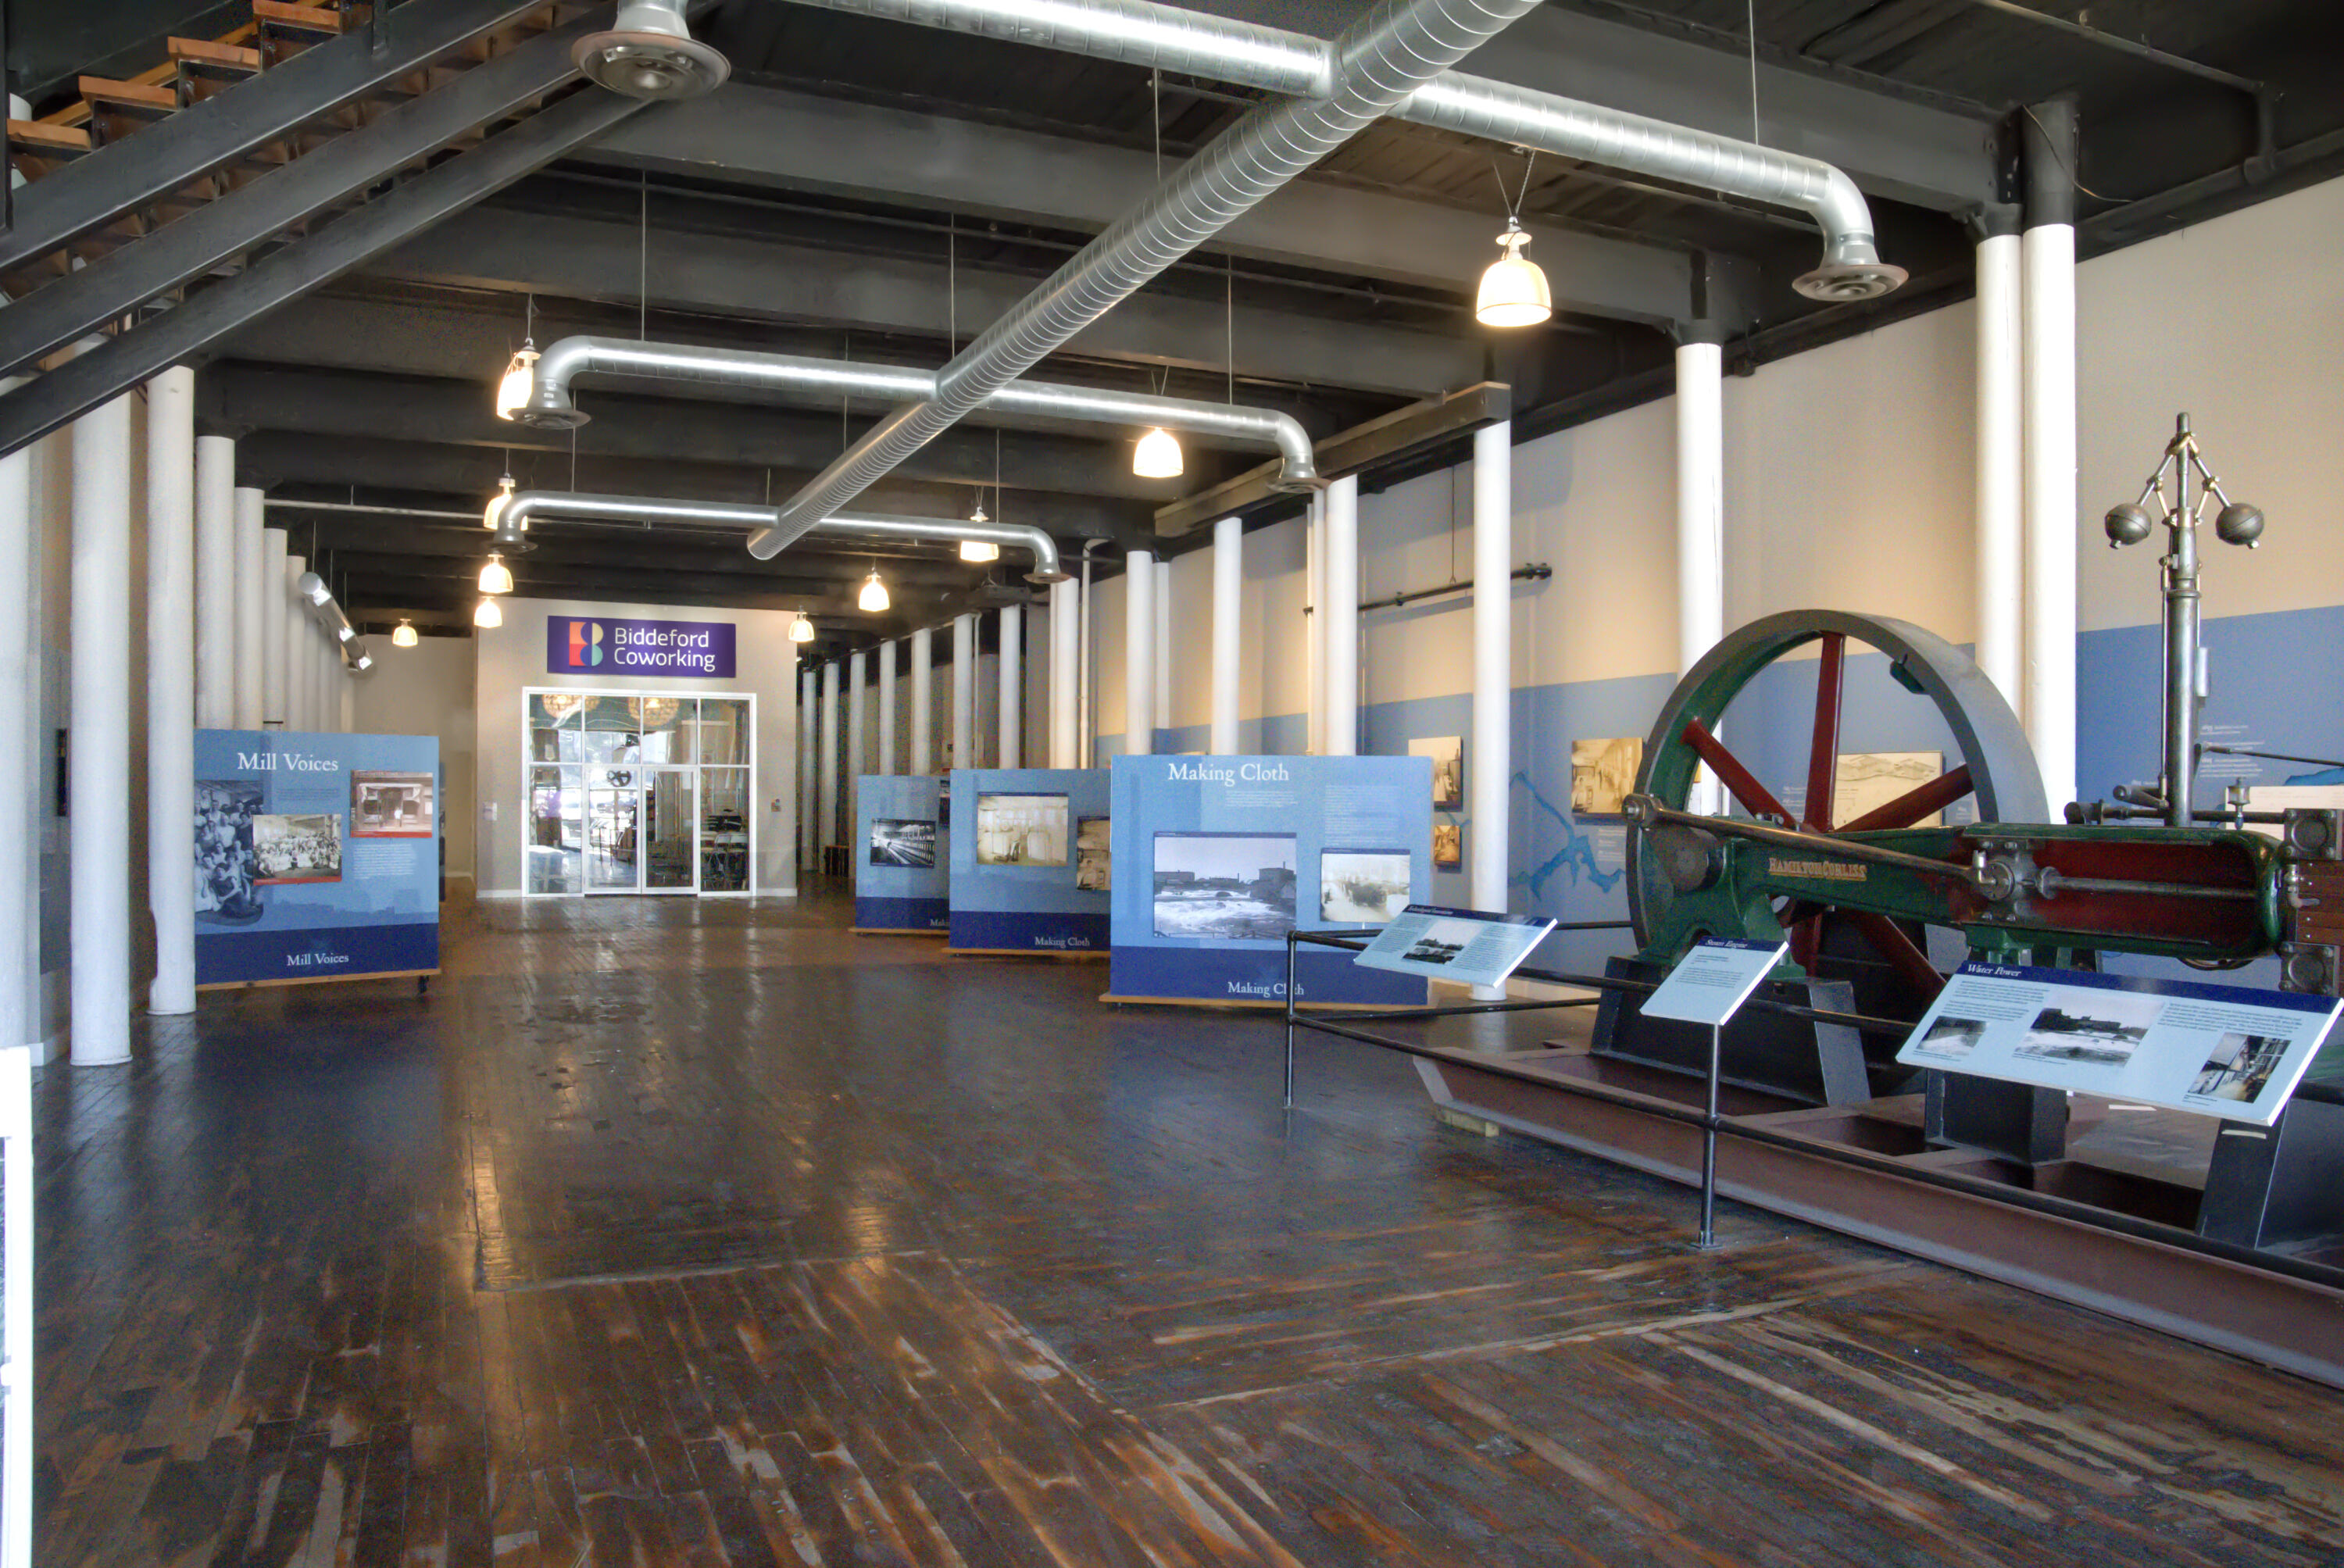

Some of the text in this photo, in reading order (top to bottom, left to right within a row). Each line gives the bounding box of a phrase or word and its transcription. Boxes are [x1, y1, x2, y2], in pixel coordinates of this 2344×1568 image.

[615, 627, 709, 648] Biddeford
[614, 648, 716, 673] Coworking
[237, 752, 338, 771] Mill Voices
[1168, 763, 1289, 787] Making Cloth
[1034, 937, 1091, 948] Making Cloth
[287, 952, 349, 966] Mill Voices
[1967, 963, 2022, 977] Water Power
[1227, 981, 1304, 998] Making Clth
